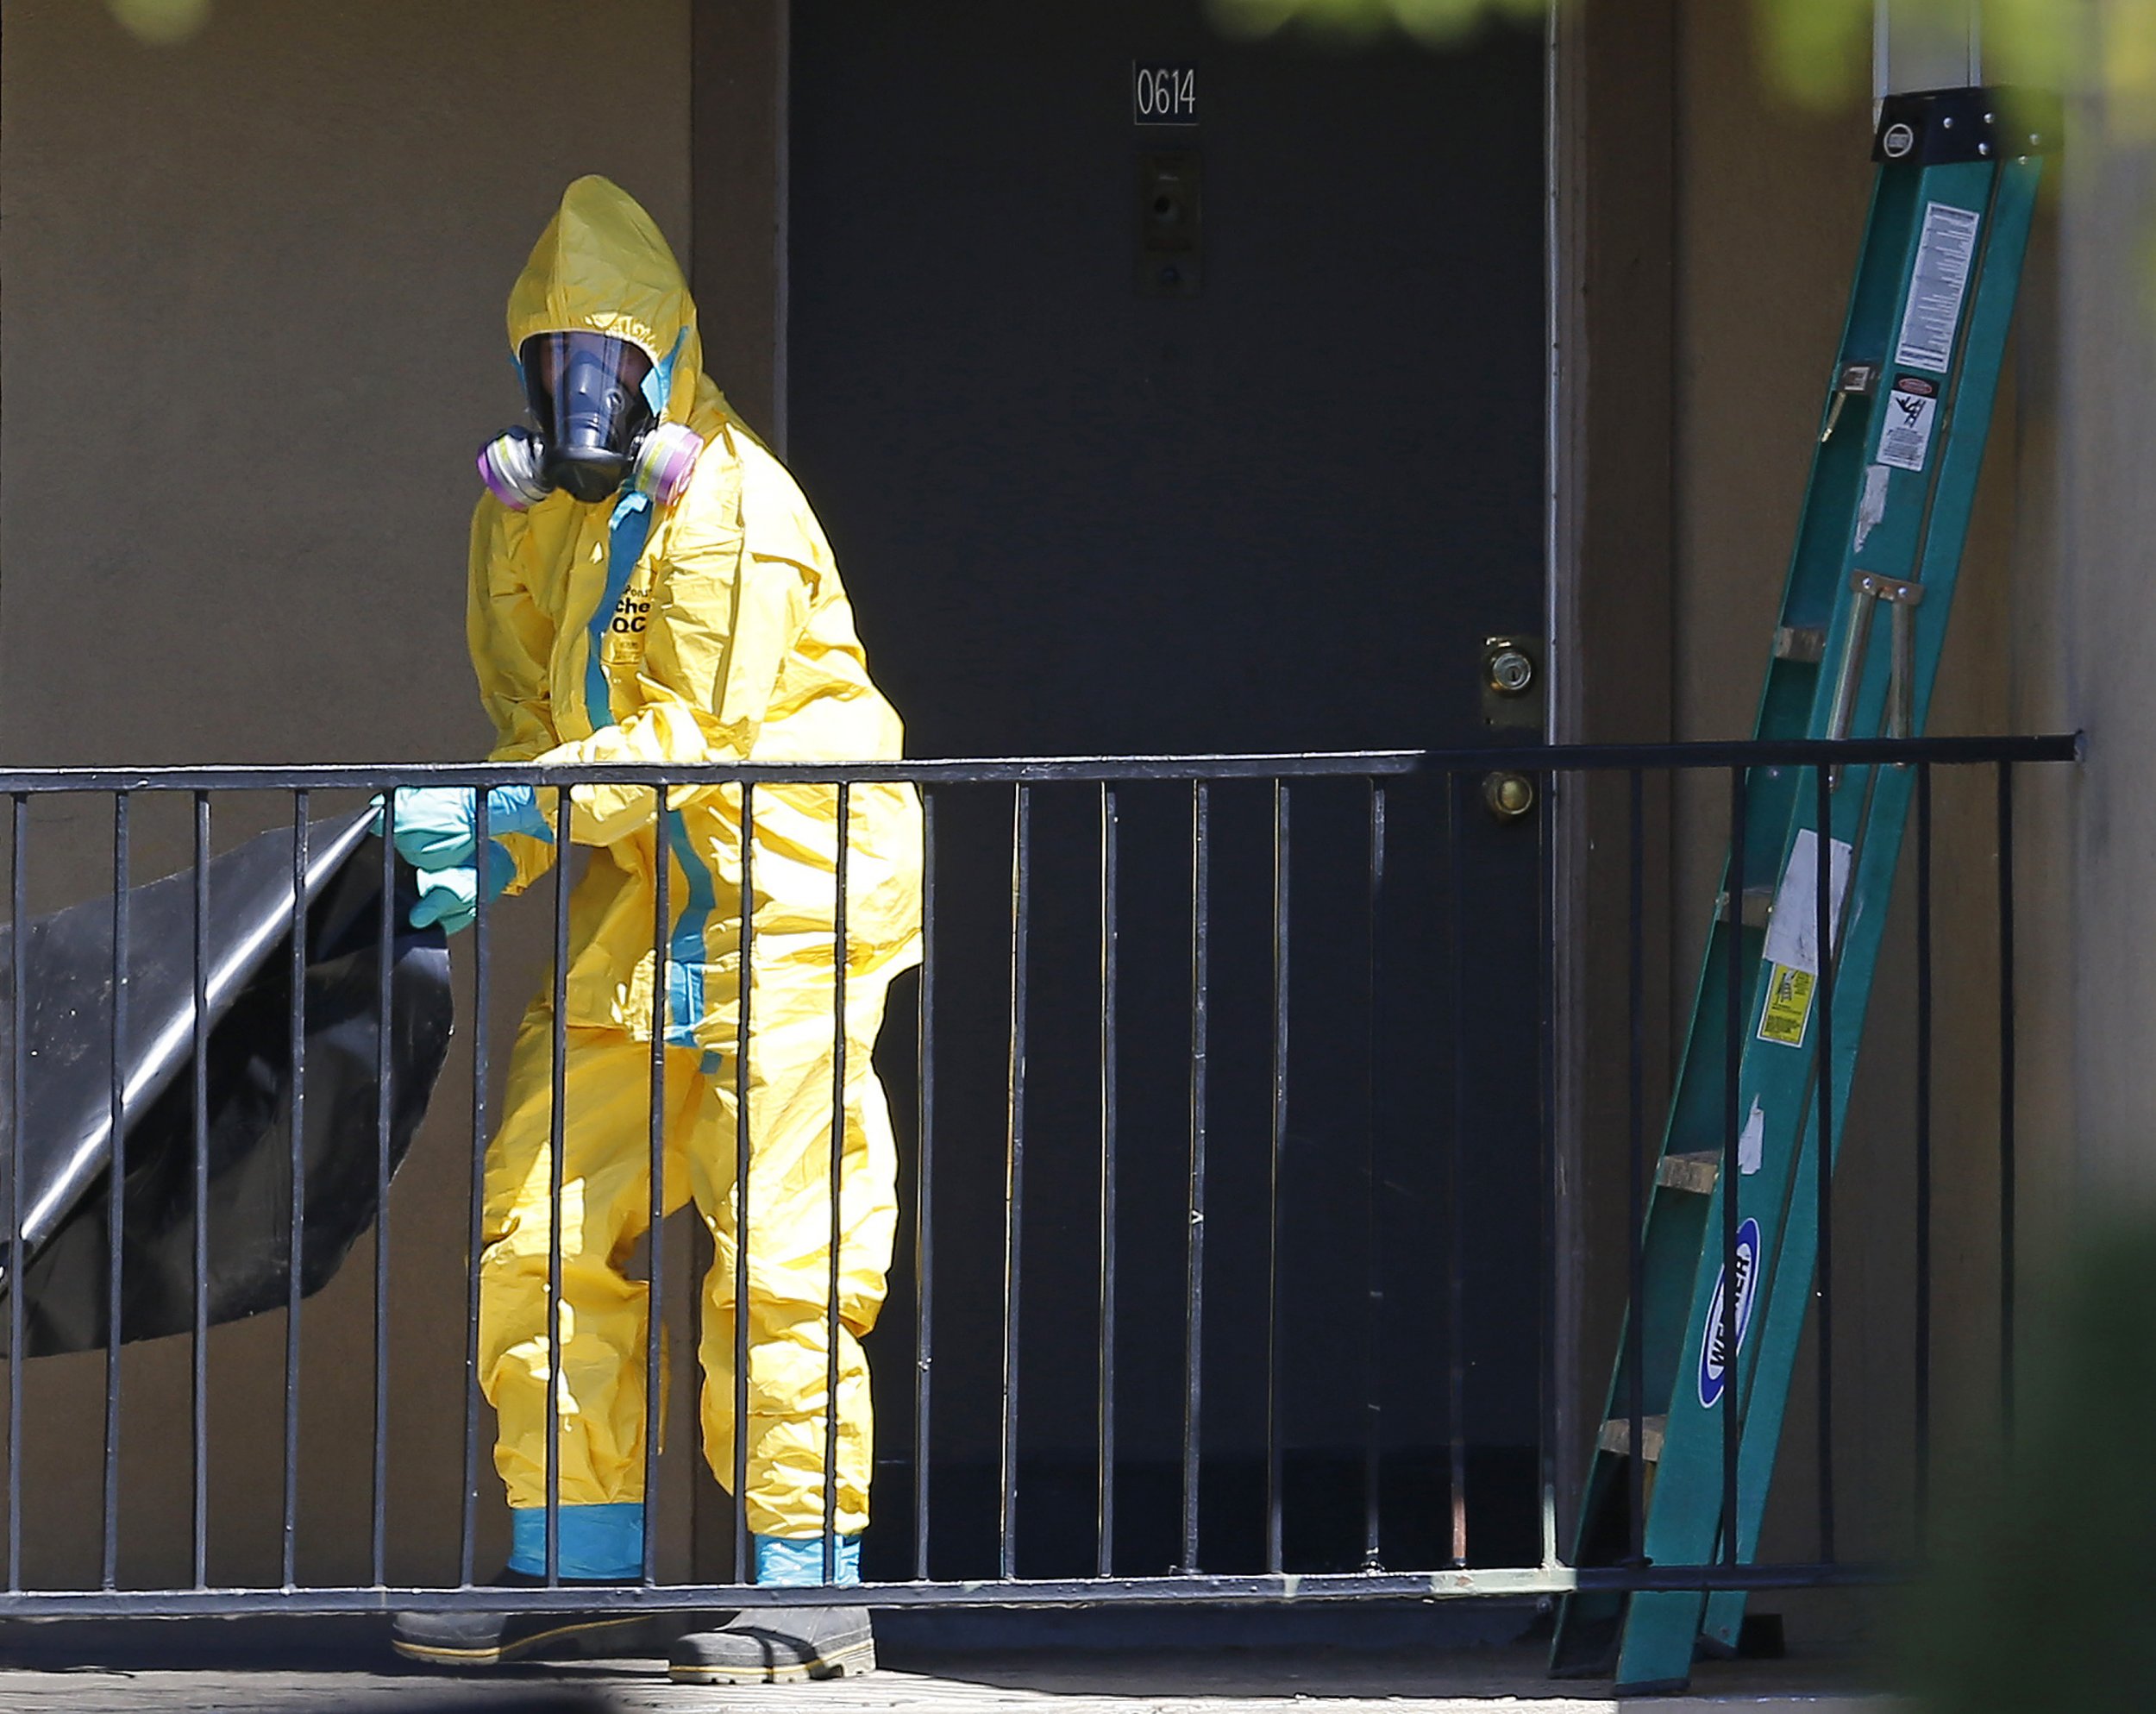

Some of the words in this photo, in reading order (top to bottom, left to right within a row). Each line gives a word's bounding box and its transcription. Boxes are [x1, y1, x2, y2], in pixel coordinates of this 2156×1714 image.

[1138, 69, 1196, 114] 0614
[616, 597, 651, 614] che
[611, 616, 647, 633] QC
[1709, 1256, 1750, 1367] WER
